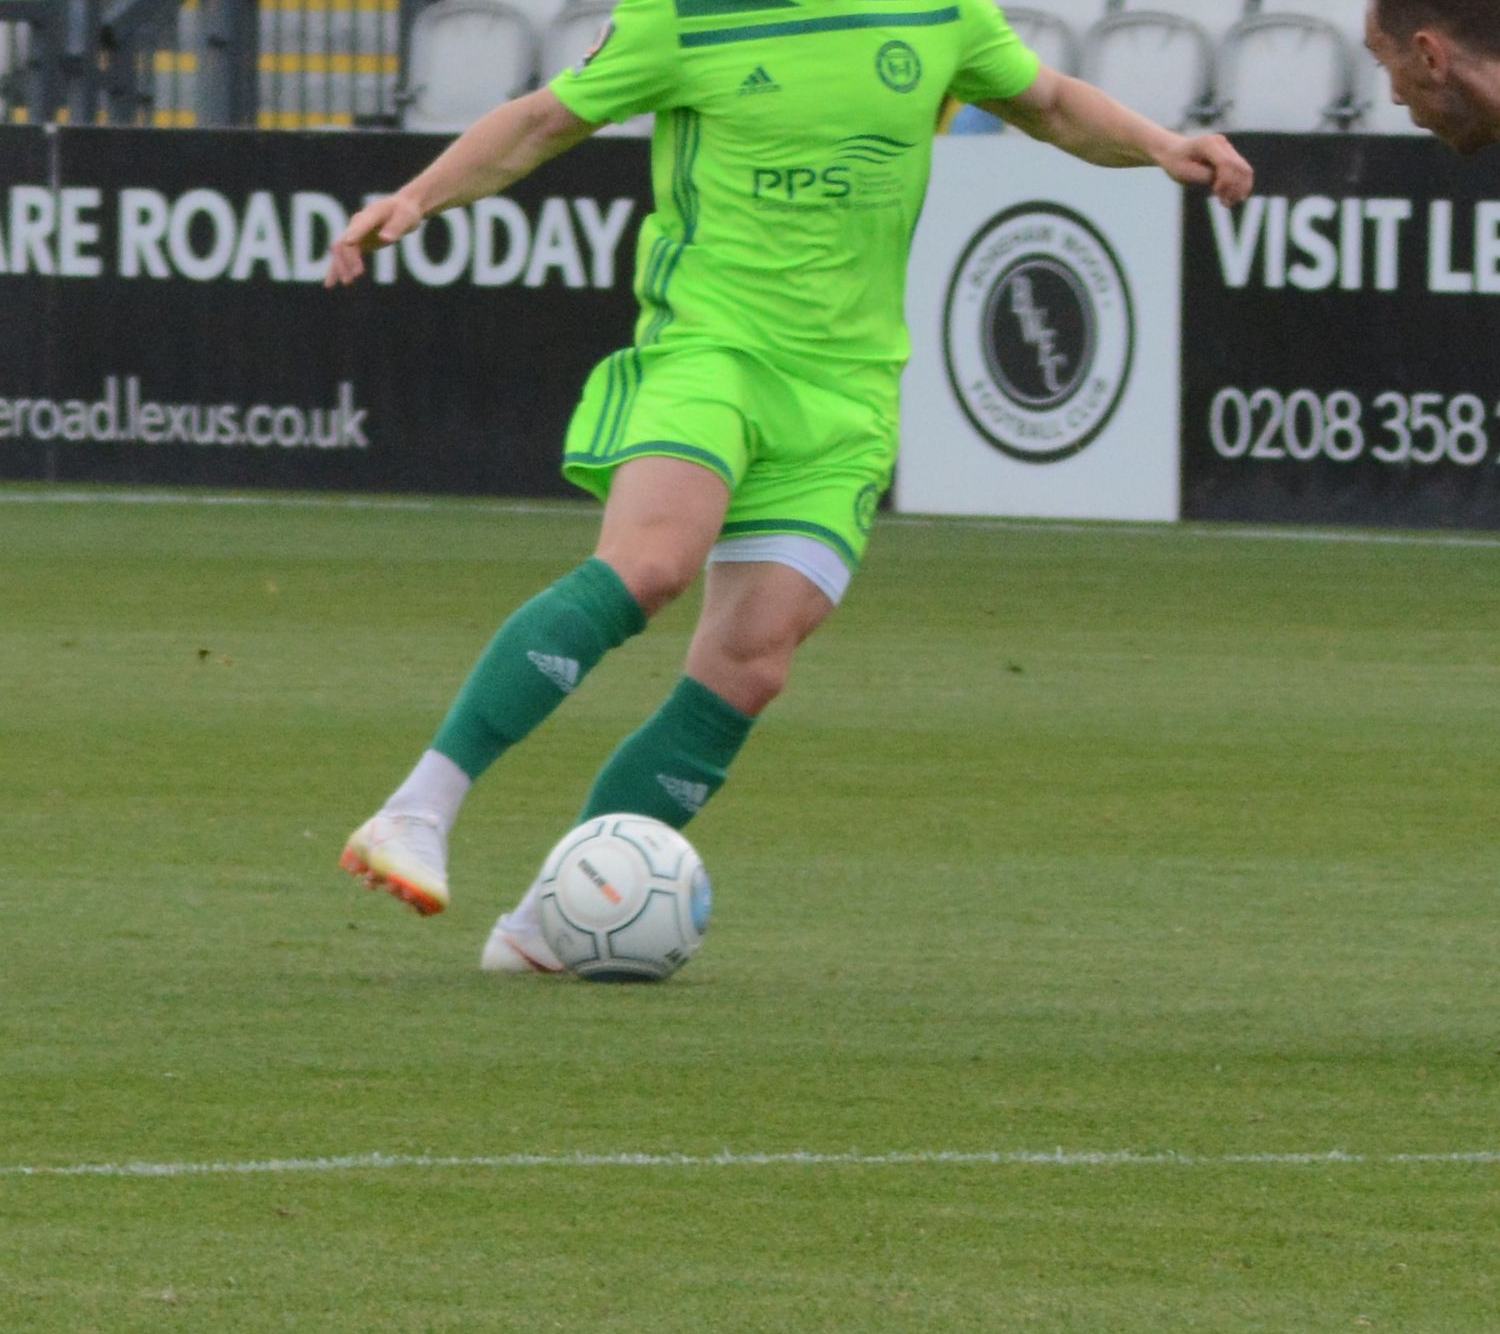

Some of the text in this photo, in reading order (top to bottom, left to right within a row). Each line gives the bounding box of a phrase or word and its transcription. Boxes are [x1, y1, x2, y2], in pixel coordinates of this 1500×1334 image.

[752, 165, 852, 200] PPS
[117, 187, 349, 284] ROAD
[1206, 194, 1413, 293] VISIT
[1209, 385, 1365, 462] 0208
[1371, 391, 1489, 464] 358
